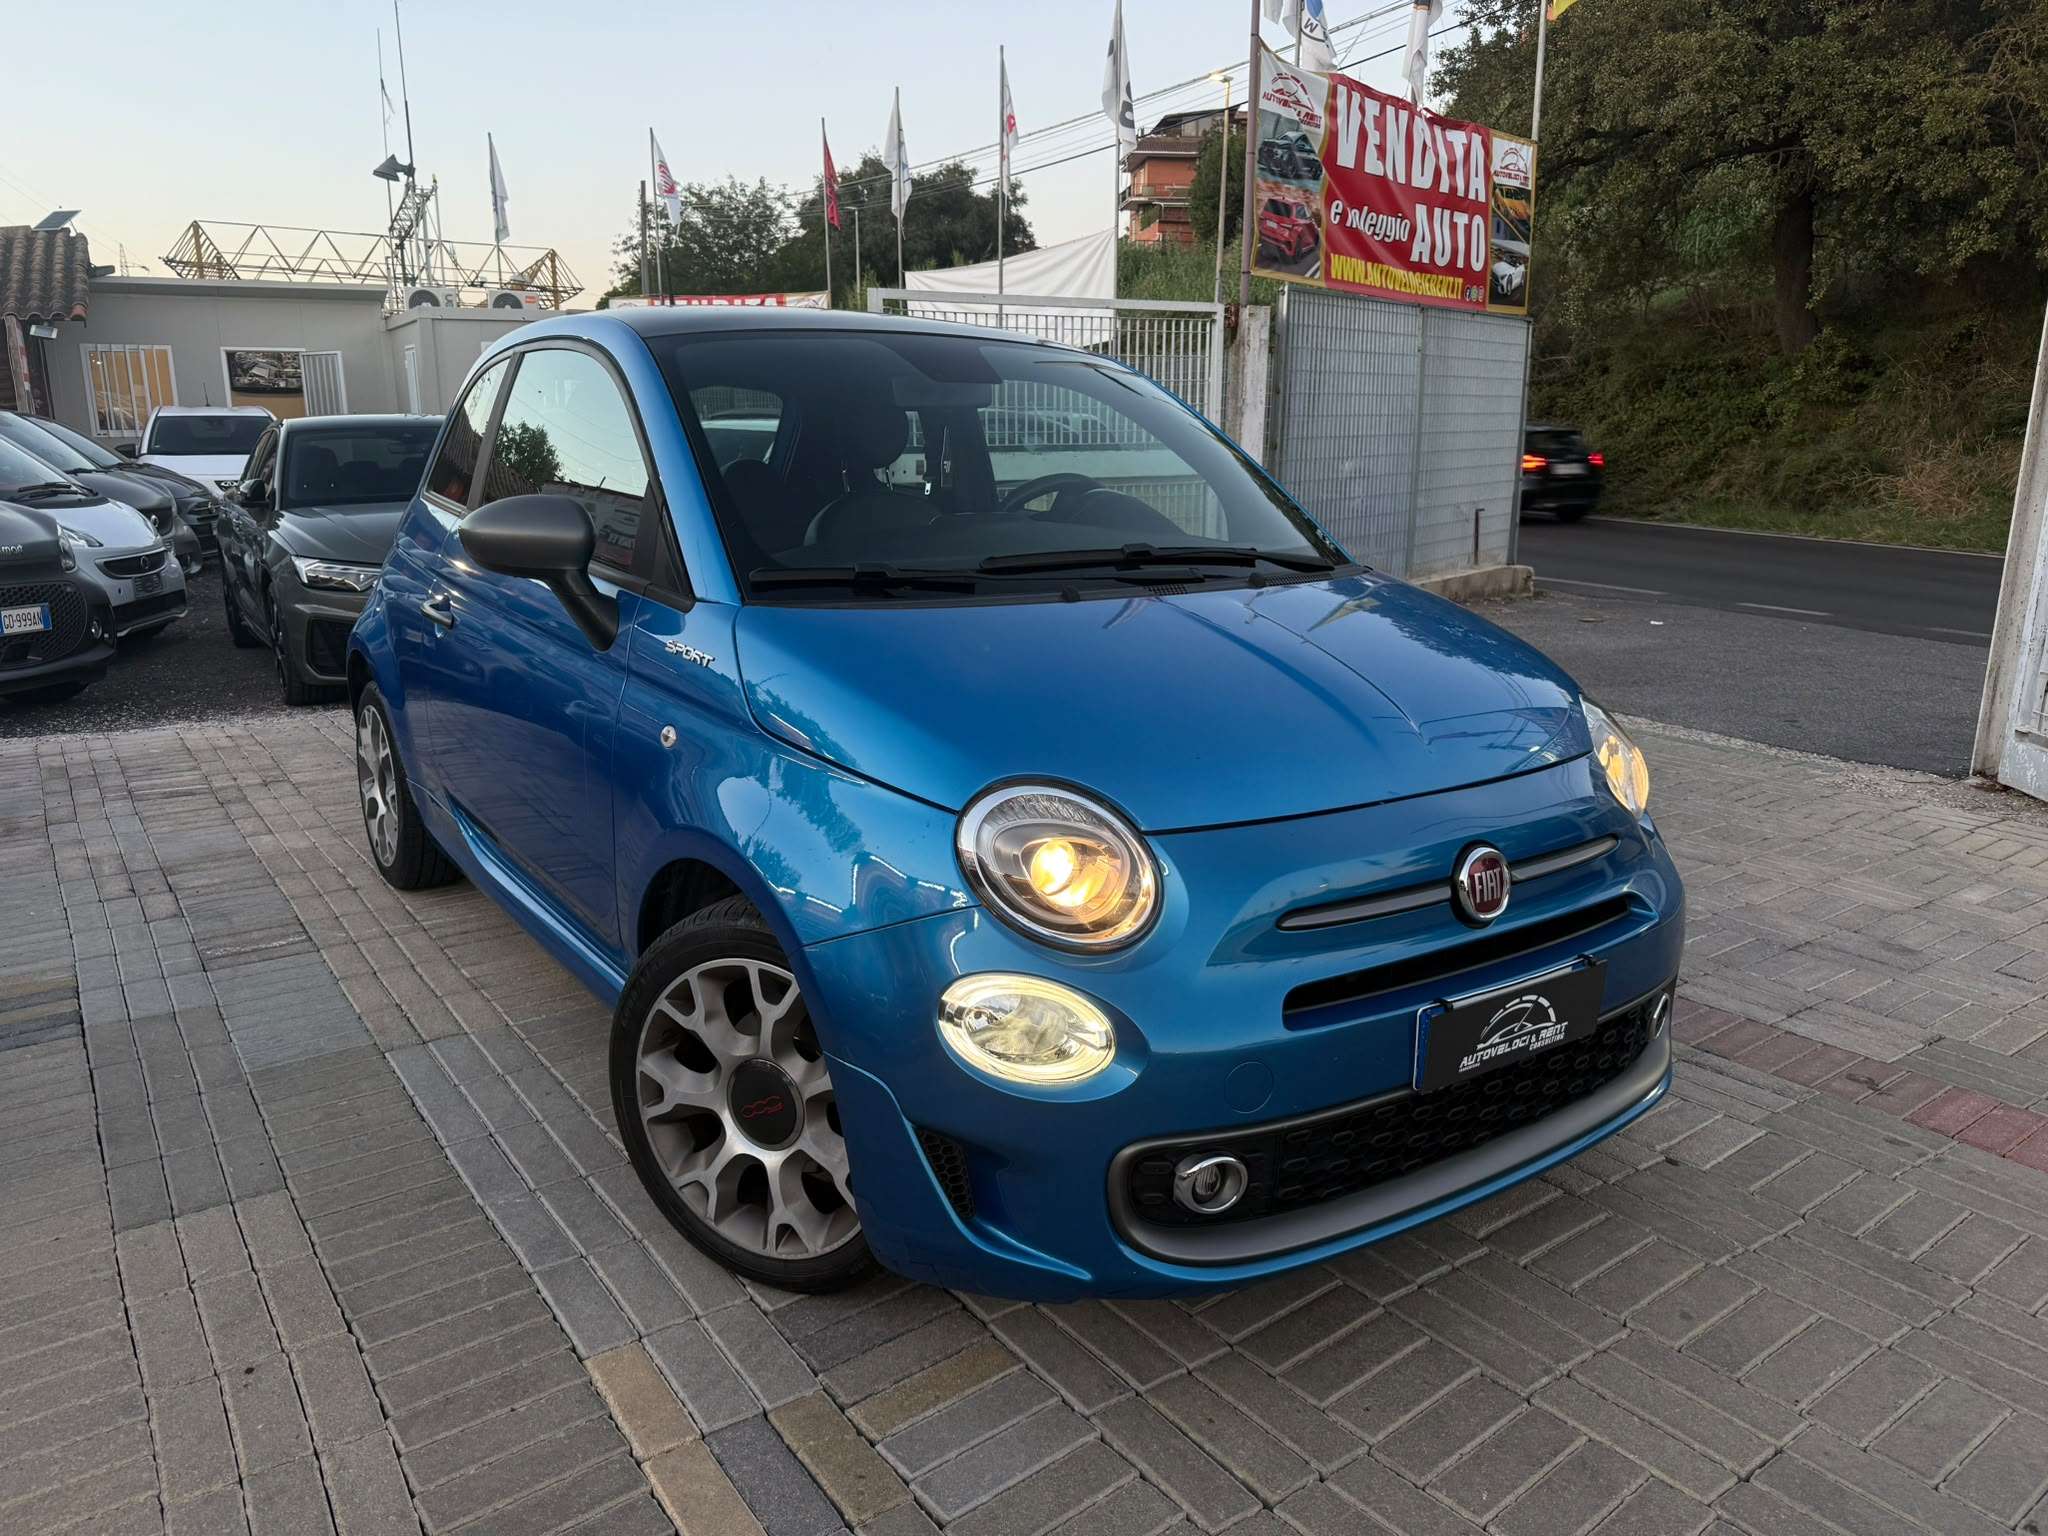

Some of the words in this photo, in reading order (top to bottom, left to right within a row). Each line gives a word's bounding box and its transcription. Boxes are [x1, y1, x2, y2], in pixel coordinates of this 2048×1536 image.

[1336, 84, 1486, 203] VENDITA
[1330, 200, 1343, 225] e
[1410, 203, 1486, 272] AUTO
[665, 640, 714, 667] SPORT
[1474, 867, 1501, 904] FIAT
[1459, 1035, 1531, 1068] AUTOVELOCI
[1538, 1021, 1568, 1041] RENT
